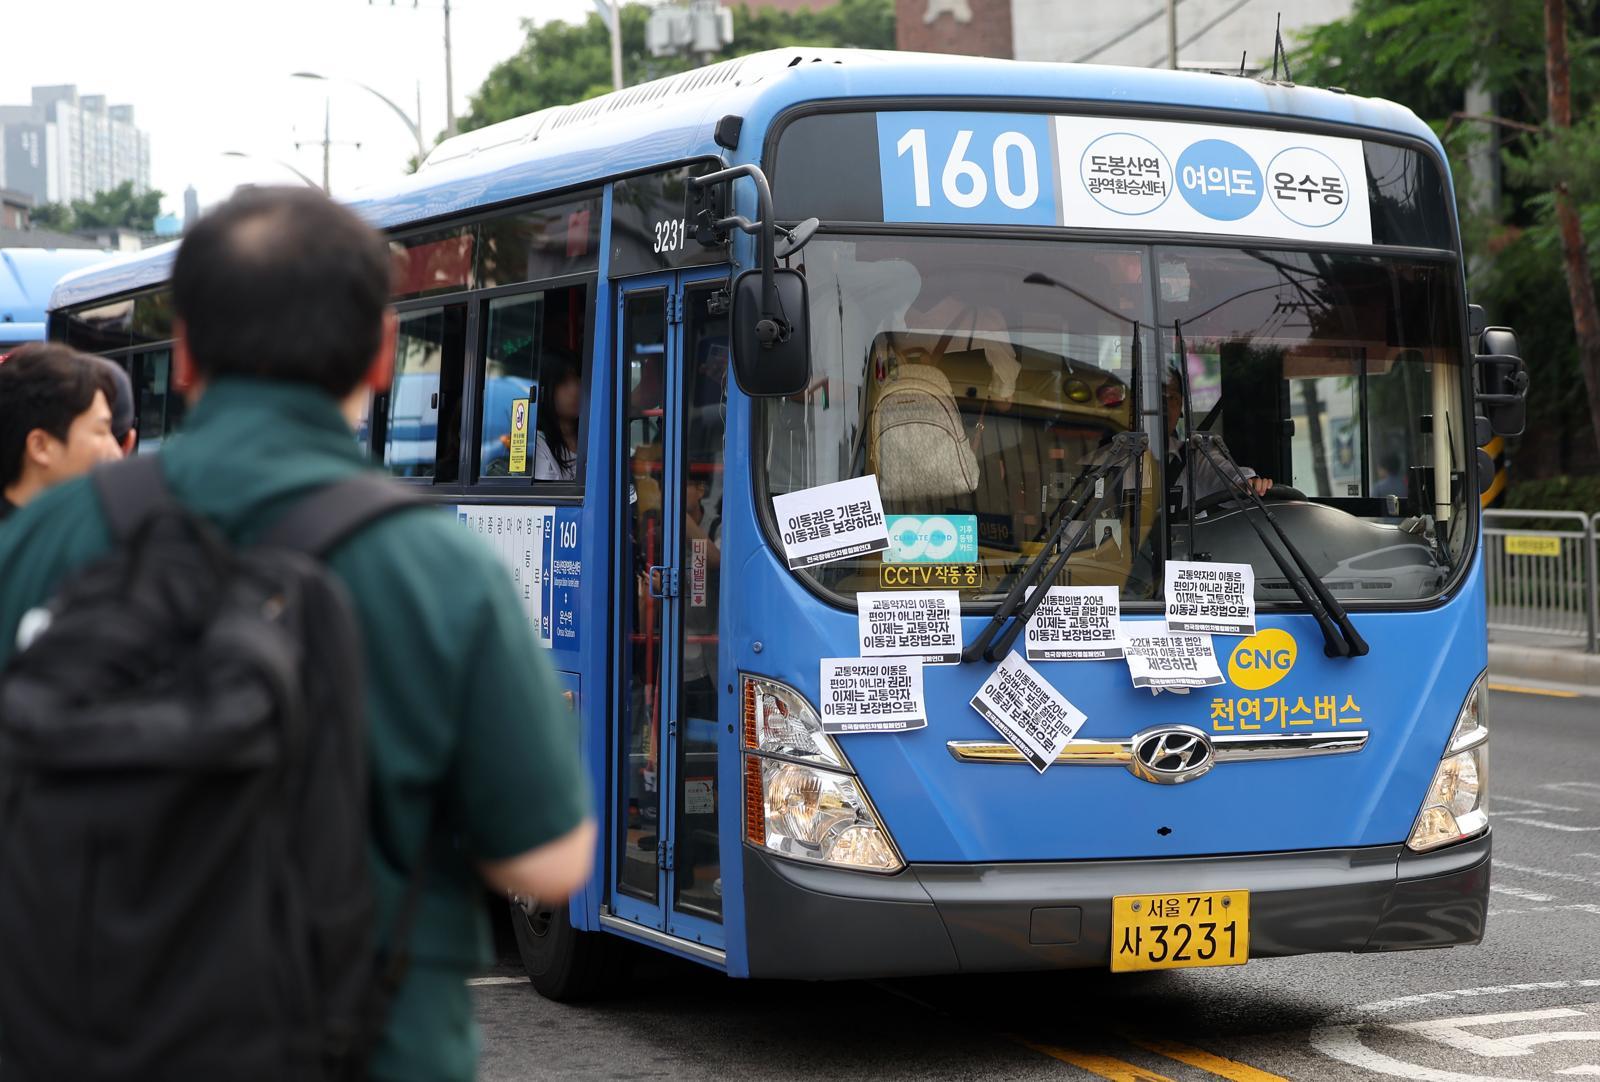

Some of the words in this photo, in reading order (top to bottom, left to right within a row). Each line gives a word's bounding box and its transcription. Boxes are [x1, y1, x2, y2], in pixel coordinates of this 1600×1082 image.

[897, 128, 1039, 210] 160
[1091, 155, 1160, 178] 도봉산역
[1088, 177, 1166, 197] 광역환승센터
[1182, 165, 1257, 197] 여의도
[1273, 172, 1344, 205] 온수동
[653, 218, 686, 254] 3231
[788, 508, 835, 530] 이동권은
[837, 500, 872, 519] 기본권
[560, 521, 577, 549] 160
[784, 523, 831, 545] 이동권을
[833, 513, 883, 535] 보장하라!
[884, 566, 932, 585] CCTV
[935, 565, 961, 585] 작동
[964, 565, 978, 585] 중
[1178, 570, 1217, 581] 교통약자의
[1218, 572, 1242, 582] 이동은
[1174, 581, 1198, 592] 편의가
[1200, 583, 1222, 593] 아니라
[1224, 582, 1245, 594] 권리!
[872, 600, 918, 610] 교통약자의
[919, 599, 946, 609] 이동은
[1041, 596, 1082, 606] 이동편의법
[1084, 596, 1104, 606] 20년
[1176, 592, 1204, 604] 이제는
[1206, 594, 1244, 606] 교통약자
[868, 612, 896, 622] 편의가
[898, 611, 924, 621] 아니라
[926, 610, 950, 621] 권리!
[1064, 606, 1080, 616] 보급
[1082, 606, 1098, 616] 절반
[1100, 606, 1117, 616] 미만
[1170, 604, 1198, 616] 이동권
[1200, 606, 1250, 618] 보장법으로!
[871, 623, 904, 635] 이제는
[906, 622, 950, 634] 교통약자
[1036, 616, 1066, 628] 이제는
[1069, 616, 1109, 628] 교통약자
[864, 636, 896, 648] 이동권
[900, 634, 956, 648] 보장법으로!
[1029, 630, 1060, 642] 이동권
[1062, 630, 1116, 642] 보장법으로!
[1130, 638, 1151, 648] 22대
[1152, 637, 1169, 648] 국회
[1170, 637, 1183, 647] 1호
[1184, 636, 1202, 647] 법안
[1160, 648, 1186, 657] 이동권
[1186, 646, 1212, 657] 보장법
[1146, 658, 1198, 671] 제정하라
[1235, 648, 1291, 670] CNG
[834, 666, 878, 676] 교통약자의
[880, 665, 908, 676] 이동은
[830, 678, 857, 690] 편의가
[860, 678, 886, 688] 아니라
[888, 676, 912, 688] 권리!
[832, 690, 866, 702] 이제는
[868, 689, 910, 701] 교통약자
[999, 667, 1026, 697] 저상버스
[1025, 694, 1041, 710] 보급
[1040, 706, 1055, 722] 절반
[1055, 720, 1072, 736] 미만
[1014, 669, 1050, 703] 이동편의법
[1048, 700, 1068, 721] 20년
[824, 704, 857, 716] 이동권
[860, 702, 918, 715] 보장법으로!
[998, 682, 1024, 709] 이제는
[1024, 708, 1058, 740] 교통약자
[1210, 694, 1363, 731] 천연가스버스
[985, 685, 1012, 713] 이동권
[1010, 709, 1056, 754] 보장법으로!
[1148, 898, 1180, 918] 서울
[1187, 896, 1212, 917] 71
